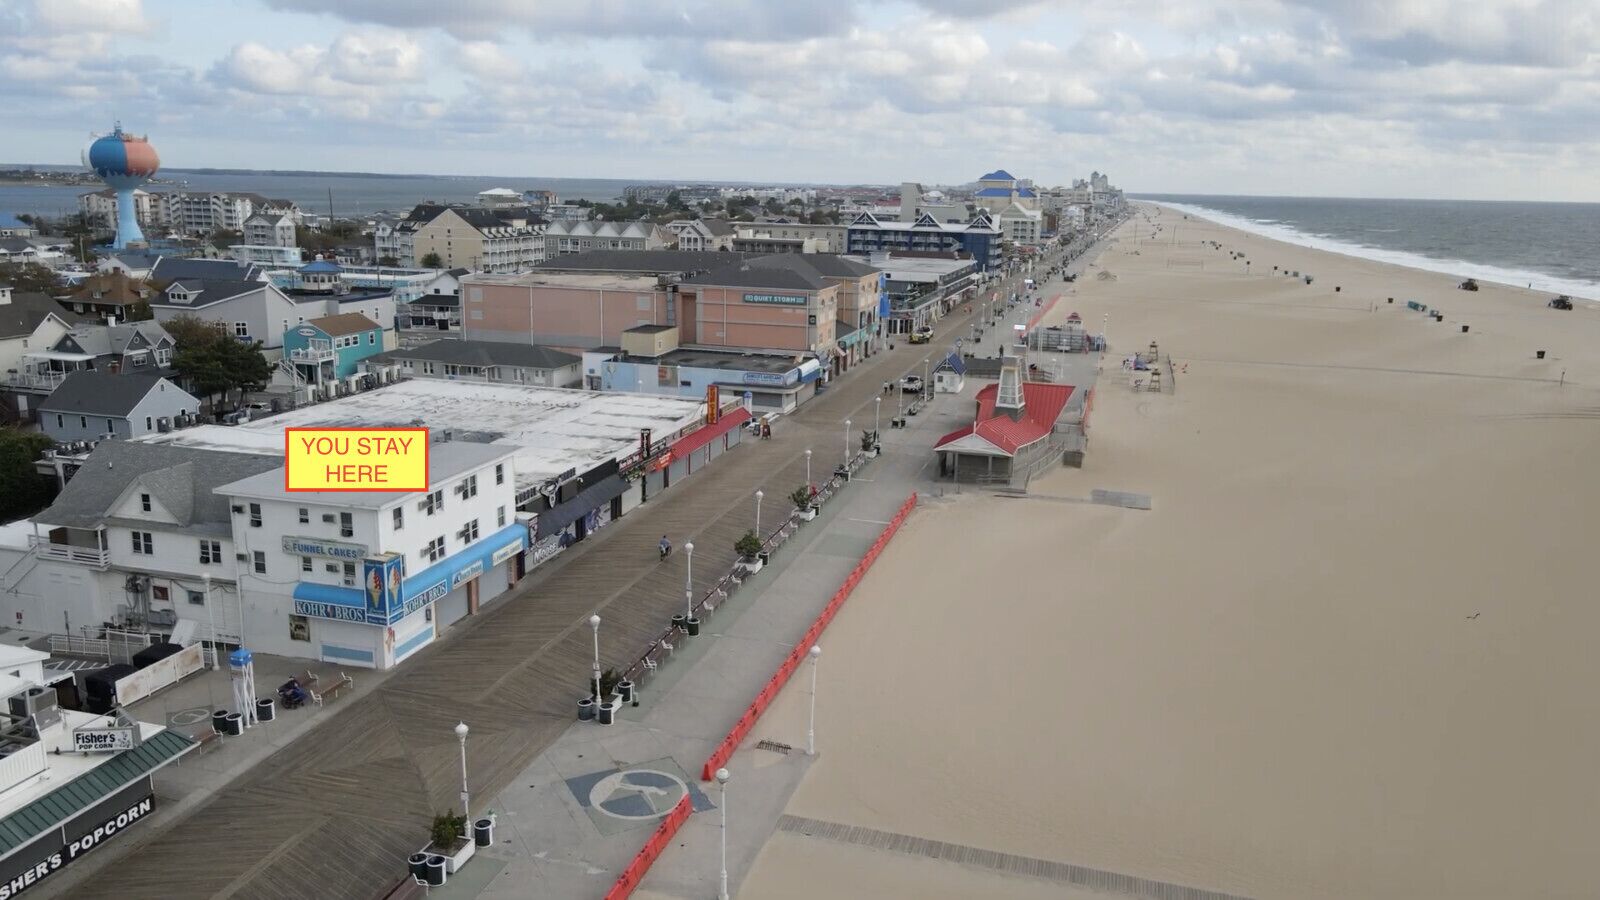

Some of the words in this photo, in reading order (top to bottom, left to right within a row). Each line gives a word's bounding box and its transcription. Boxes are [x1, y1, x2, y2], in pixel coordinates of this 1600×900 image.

[753, 294, 772, 302] QUIET
[773, 295, 796, 303] STORM
[292, 543, 326, 555] FUNNEL
[328, 545, 358, 558] CAKES
[404, 595, 425, 615] KOHR
[428, 584, 447, 603] BROS
[296, 601, 328, 617] KOHR
[335, 607, 364, 622] BROS
[75, 731, 116, 744] Fisher's
[69, 799, 151, 859] POPCORN
